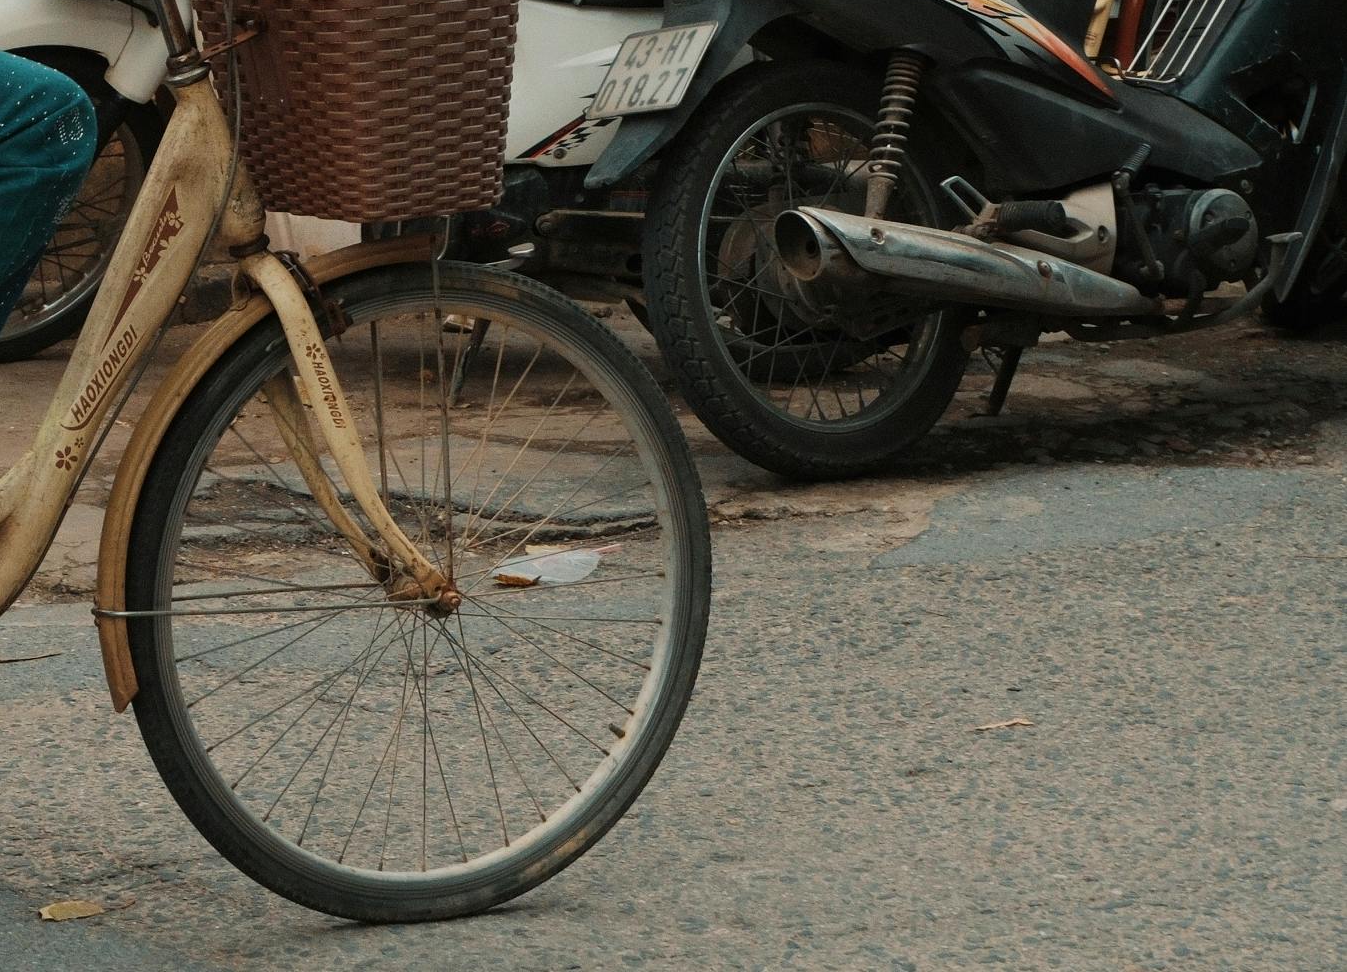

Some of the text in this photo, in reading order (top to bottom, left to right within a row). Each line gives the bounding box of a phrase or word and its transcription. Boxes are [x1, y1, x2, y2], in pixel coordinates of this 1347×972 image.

[596, 67, 689, 112] 018.27
[70, 324, 138, 423] HAOXIONGDI
[312, 361, 347, 429] HAOXIONGDI
